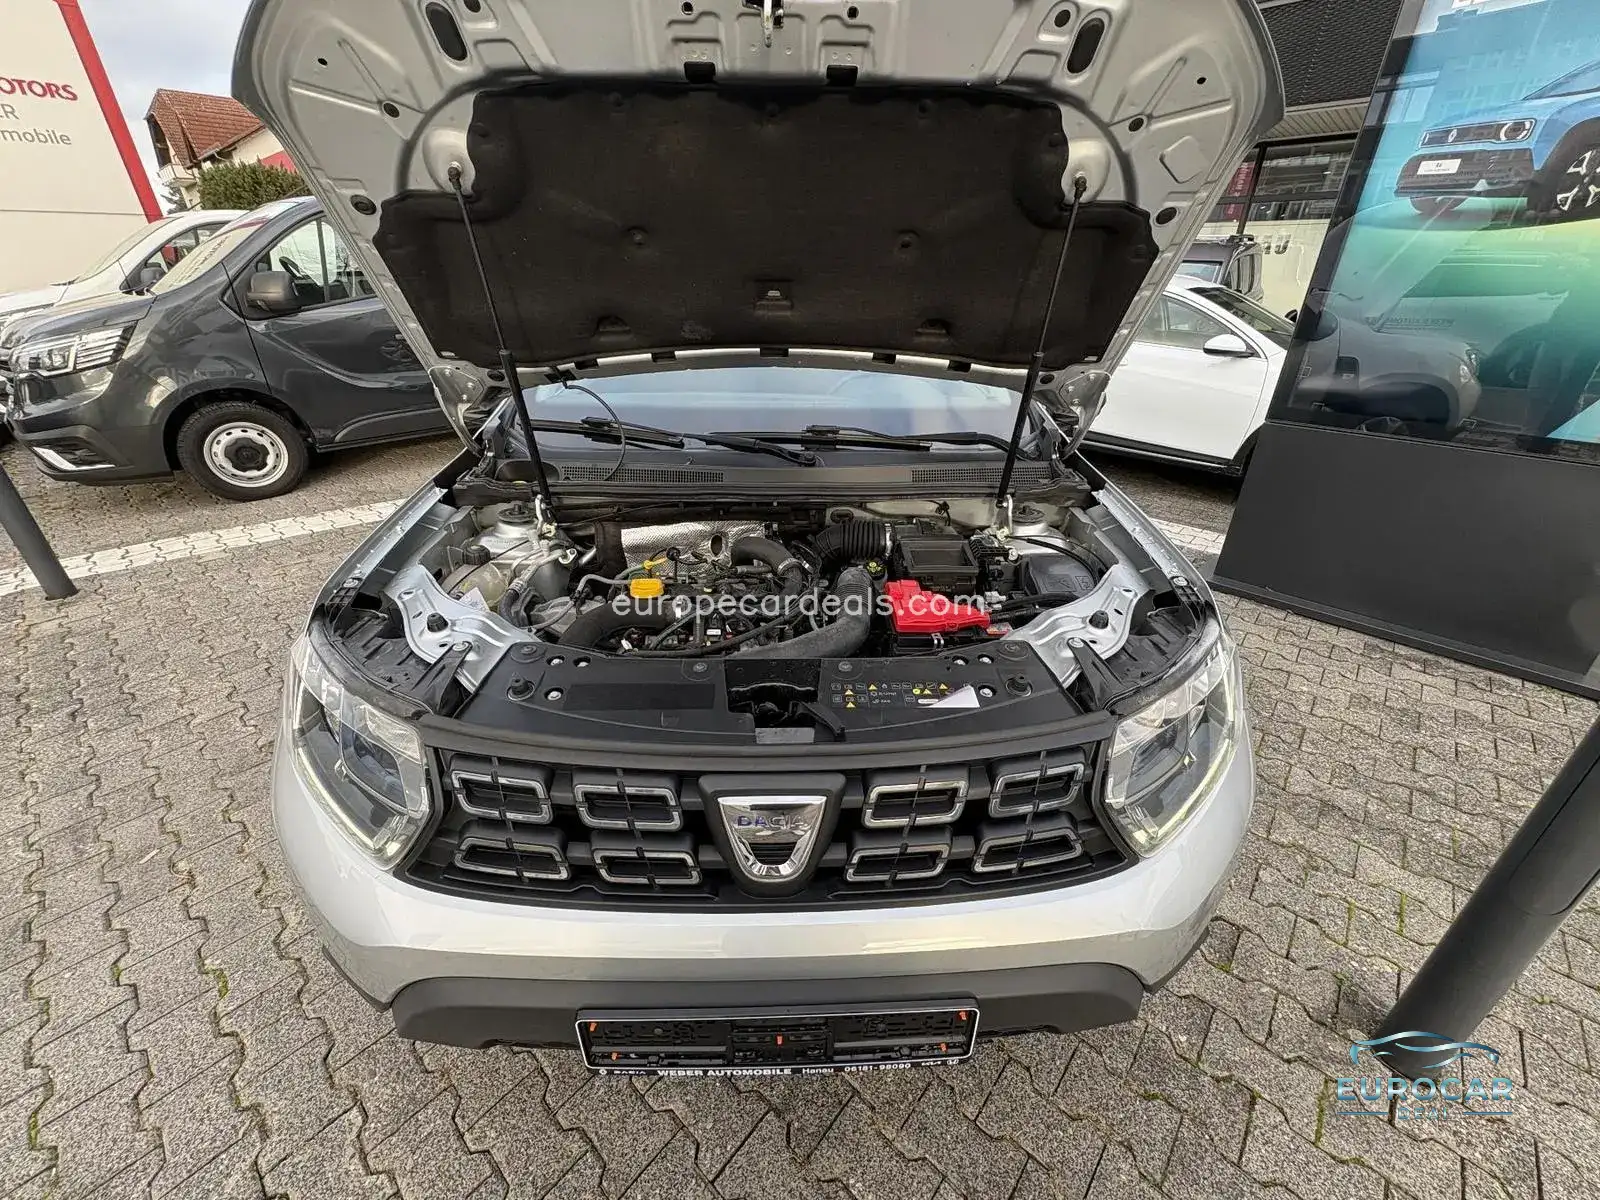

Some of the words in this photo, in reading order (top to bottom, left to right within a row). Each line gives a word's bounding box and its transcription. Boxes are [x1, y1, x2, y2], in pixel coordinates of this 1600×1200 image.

[0, 128, 72, 145] mobile
[657, 1069, 703, 1077] WEBER
[707, 1067, 792, 1077] AUTOMOBILE
[802, 1067, 835, 1075] Hanau
